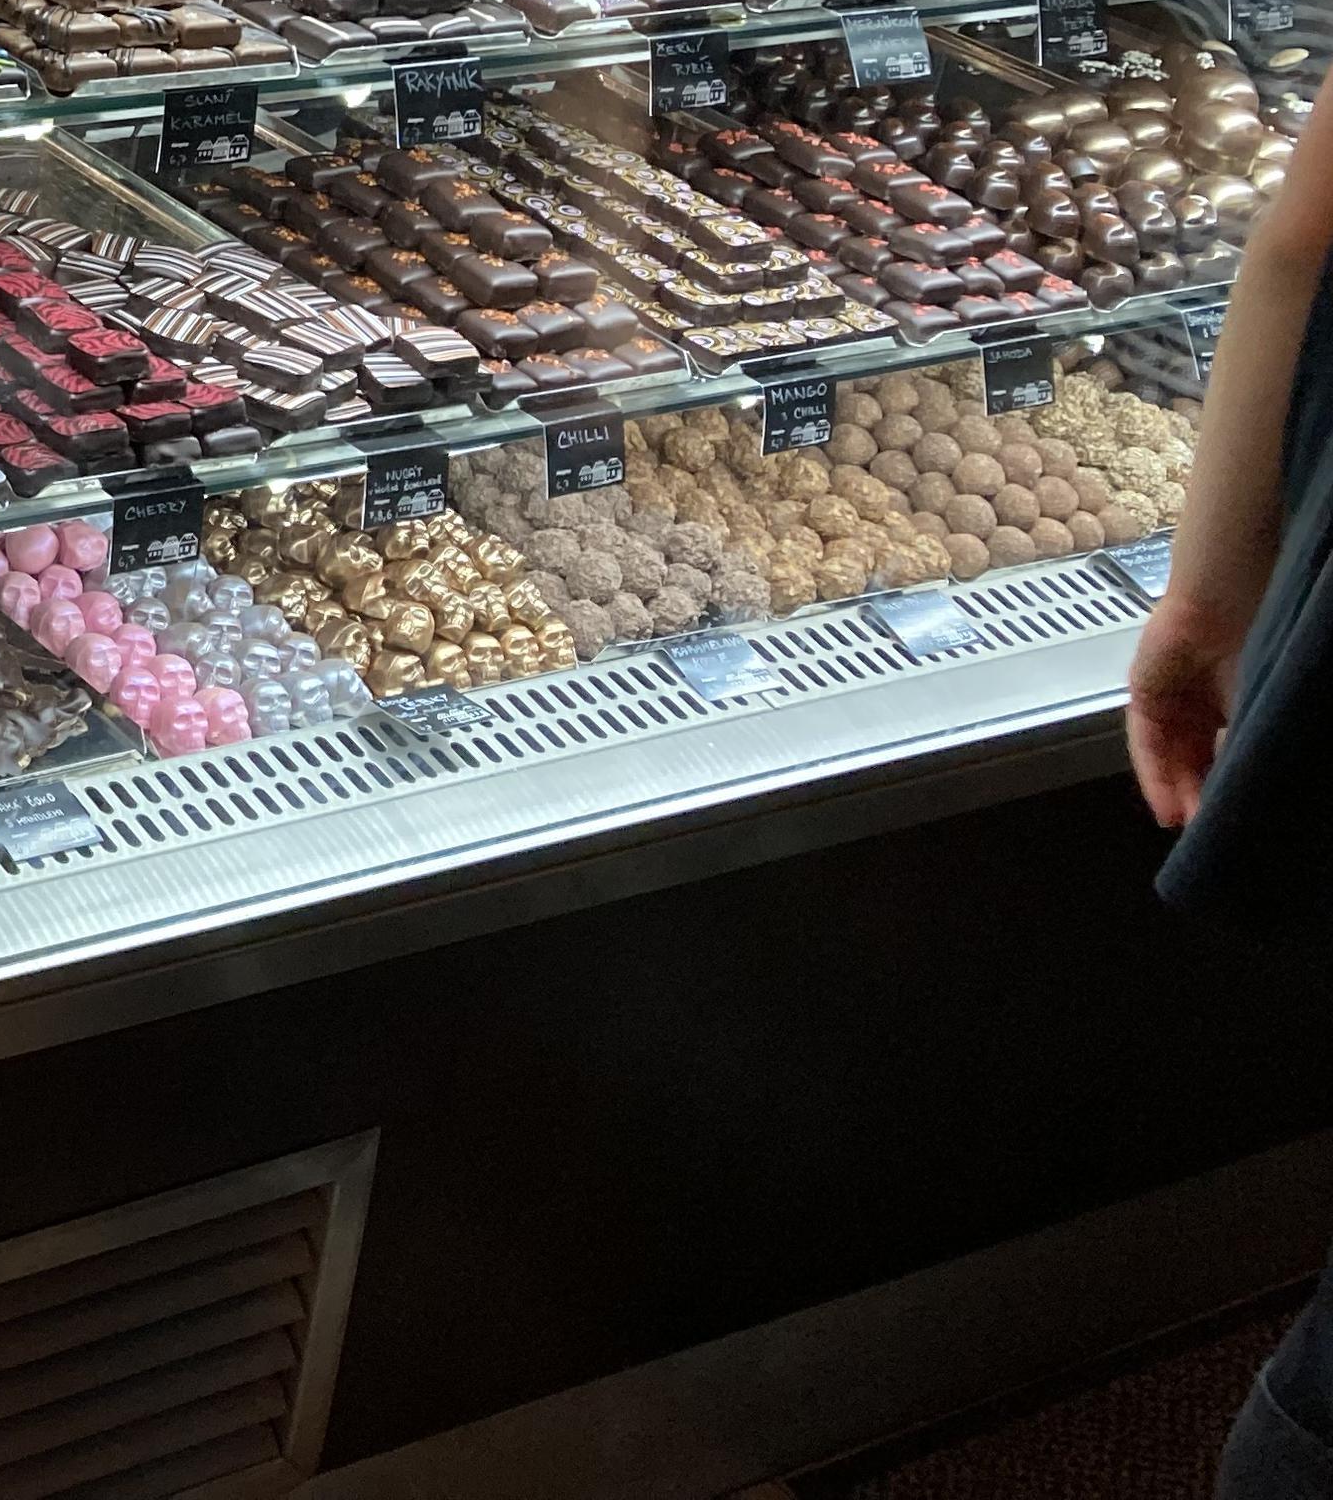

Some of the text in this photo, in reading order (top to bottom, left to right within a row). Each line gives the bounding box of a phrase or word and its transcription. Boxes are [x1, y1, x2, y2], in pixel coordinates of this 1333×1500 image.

[170, 111, 252, 131] KARAMEL
[770, 381, 830, 406] MANGO
[792, 403, 829, 421] CHILLI
[556, 424, 611, 449] CHILLI
[124, 500, 188, 521] CHERRY
